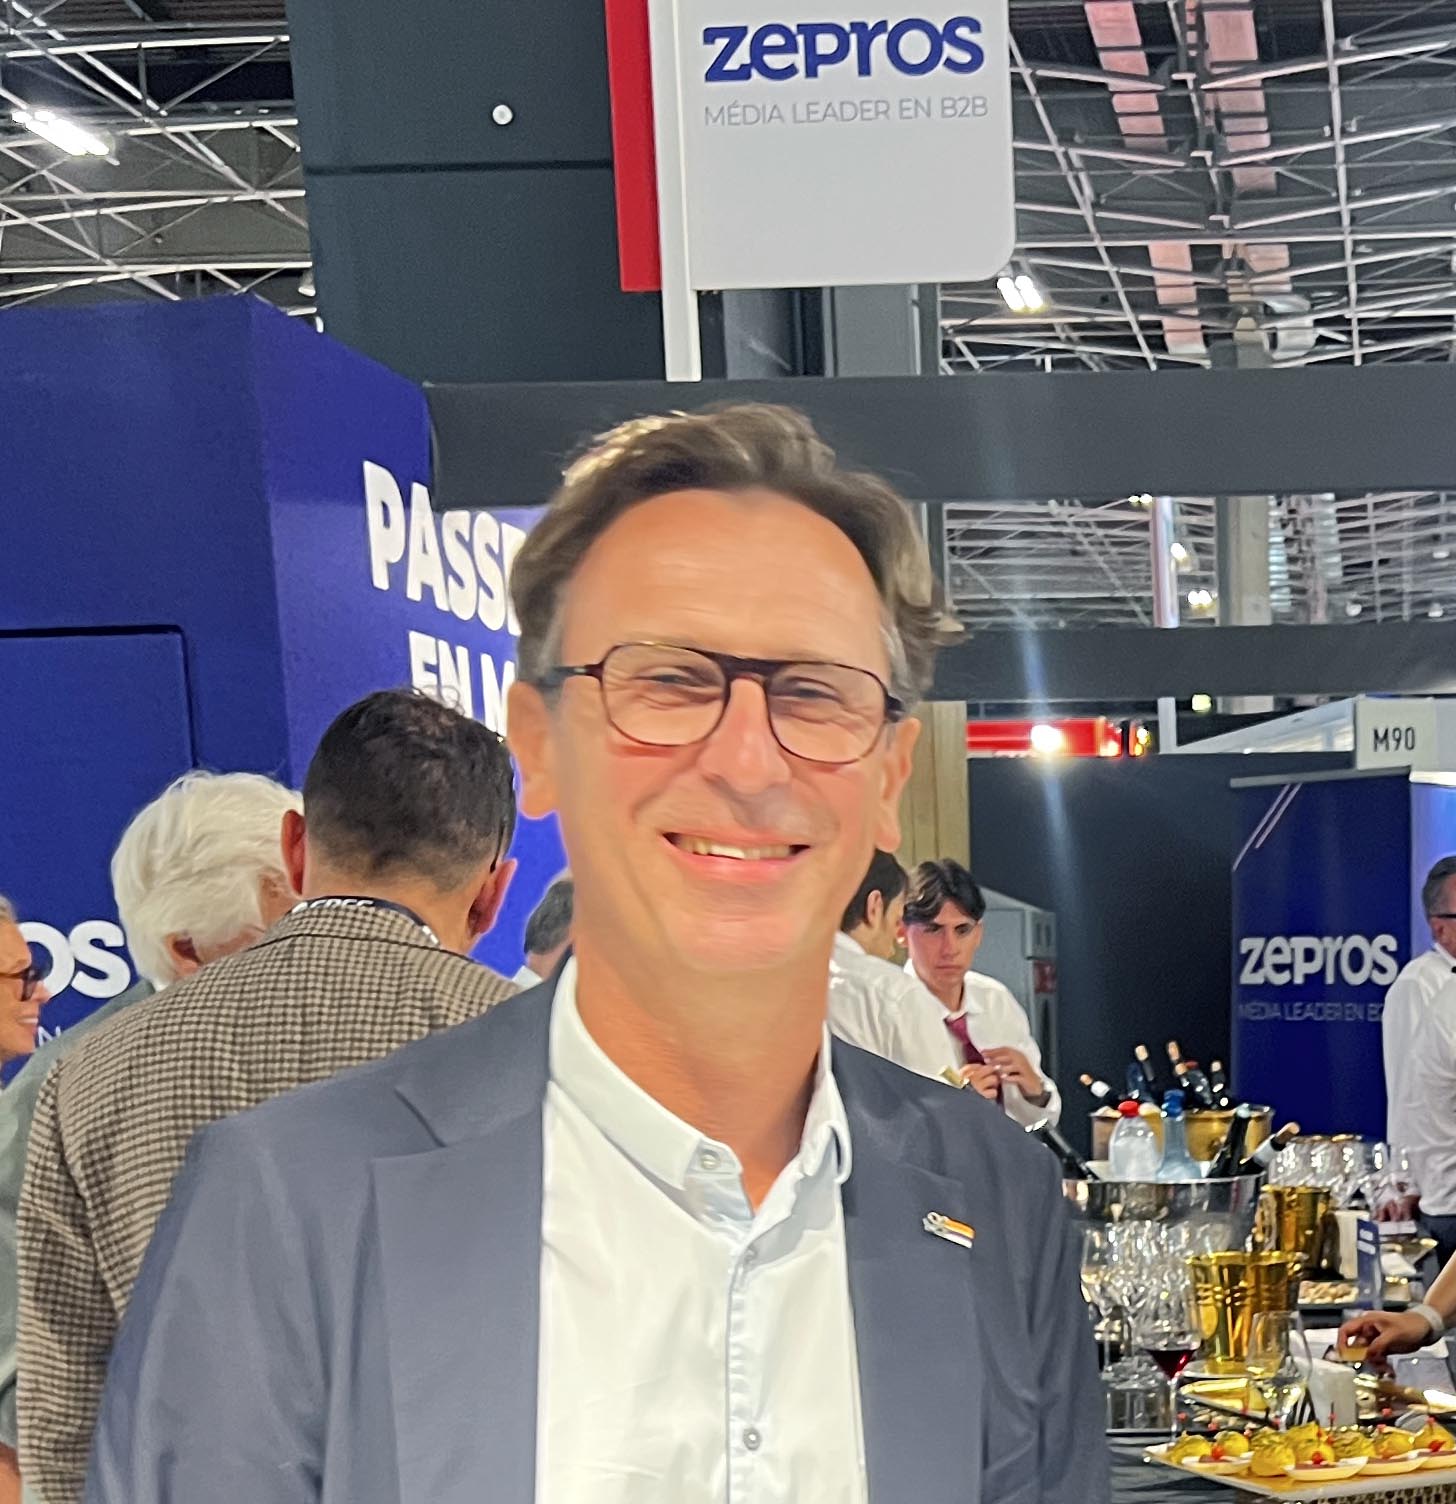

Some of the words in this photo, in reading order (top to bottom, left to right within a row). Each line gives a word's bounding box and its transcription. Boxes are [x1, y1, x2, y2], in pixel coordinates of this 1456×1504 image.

[704, 100, 784, 127] MÉDIA
[792, 98, 890, 125] LEADER
[898, 97, 931, 120] EN
[941, 95, 989, 119] B2B
[1372, 727, 1416, 753] M90
